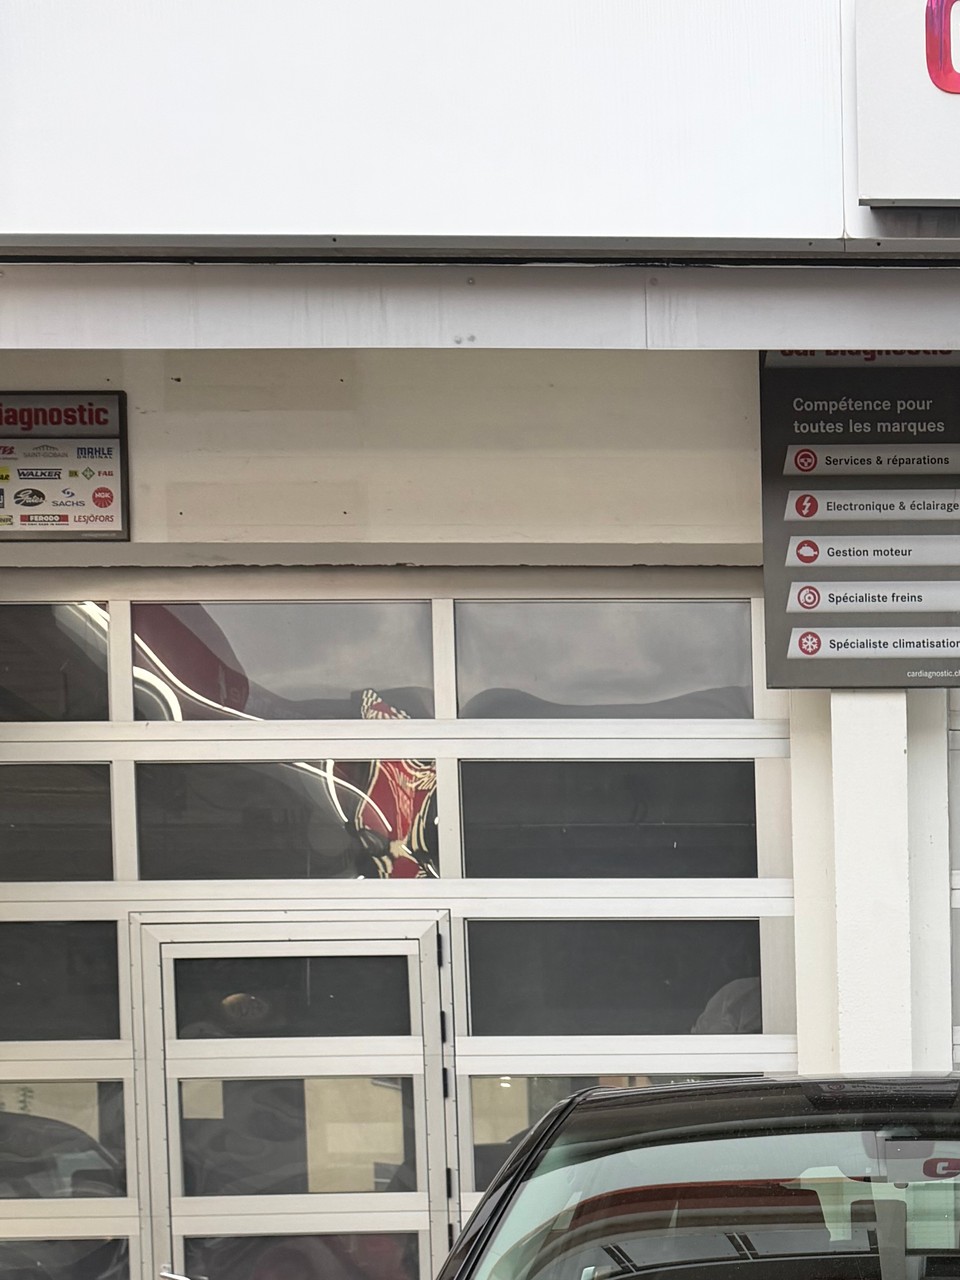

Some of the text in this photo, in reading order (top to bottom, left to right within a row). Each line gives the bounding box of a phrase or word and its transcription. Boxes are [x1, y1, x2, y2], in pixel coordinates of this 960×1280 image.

[793, 397, 933, 415] Compétence pour
[793, 419, 945, 435] toutes les marques
[77, 447, 113, 455] MAHLE
[825, 455, 950, 468] Services & réparations
[17, 468, 62, 480] WALKER
[826, 500, 960, 516] Electronique & éclairage
[74, 514, 115, 524] LESJÖFORS
[827, 547, 913, 557] Gestion moteur
[828, 592, 923, 606] Spécialiste freins
[829, 638, 889, 651] Spécialiste
